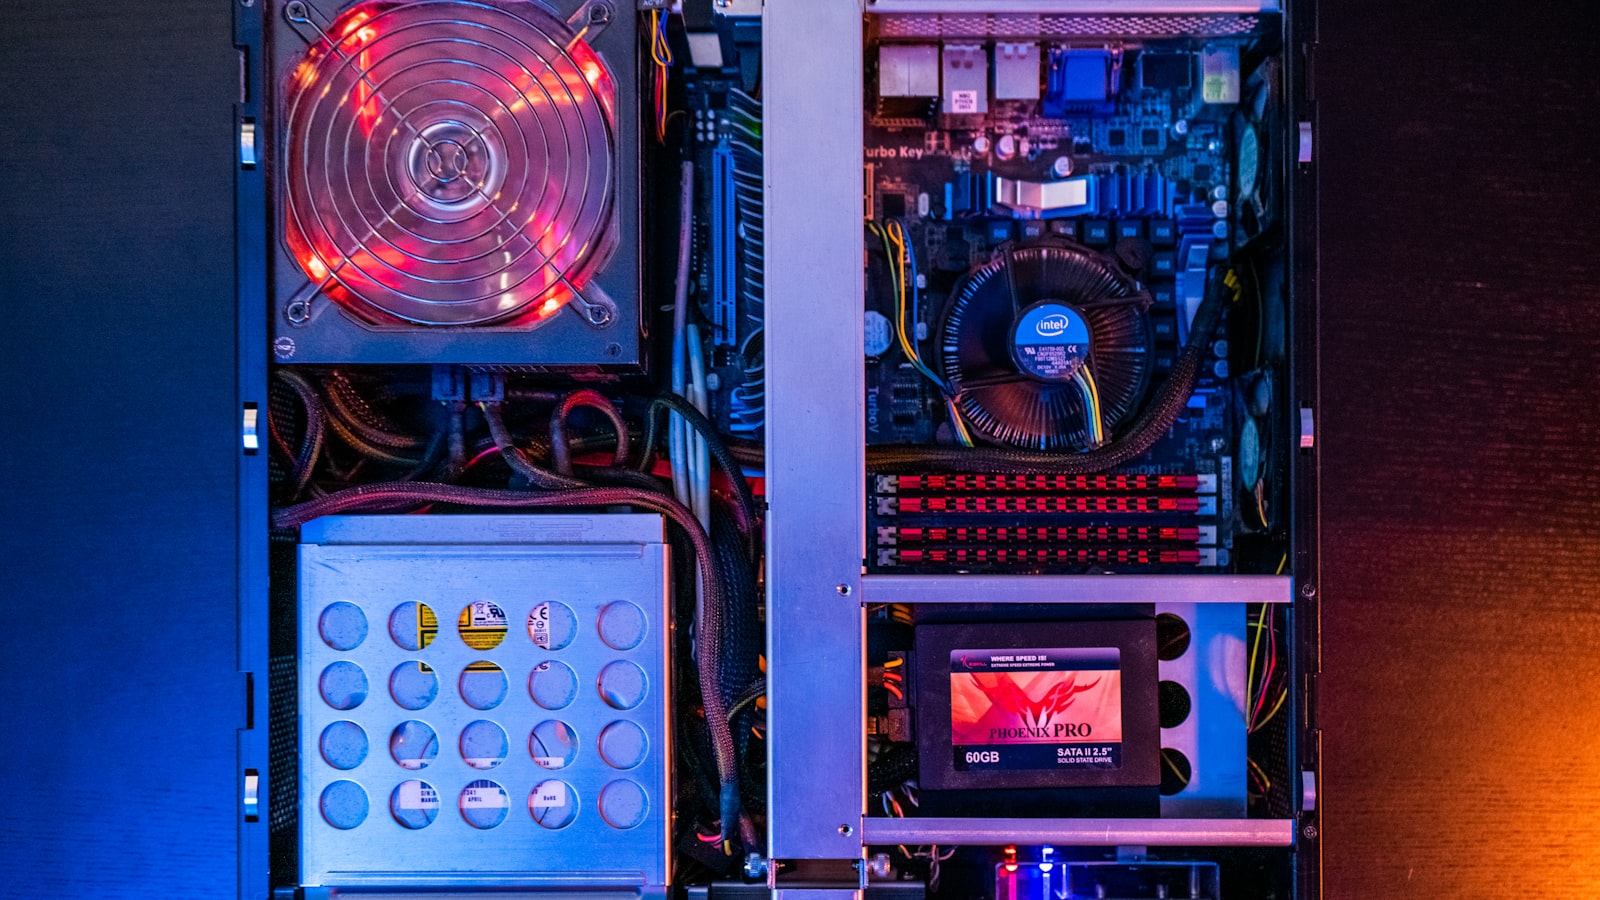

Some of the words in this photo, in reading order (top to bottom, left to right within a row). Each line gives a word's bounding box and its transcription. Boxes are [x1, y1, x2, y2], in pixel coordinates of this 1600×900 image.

[864, 145, 897, 158] urbo
[900, 146, 924, 160] Key
[1040, 319, 1064, 330] intel
[868, 385, 880, 433] TurboV
[989, 727, 1050, 739] PHOENIX
[1053, 723, 1092, 737] PRO
[965, 751, 1000, 764] 60GB
[1057, 747, 1084, 757] SATA
[1084, 747, 1091, 756] II
